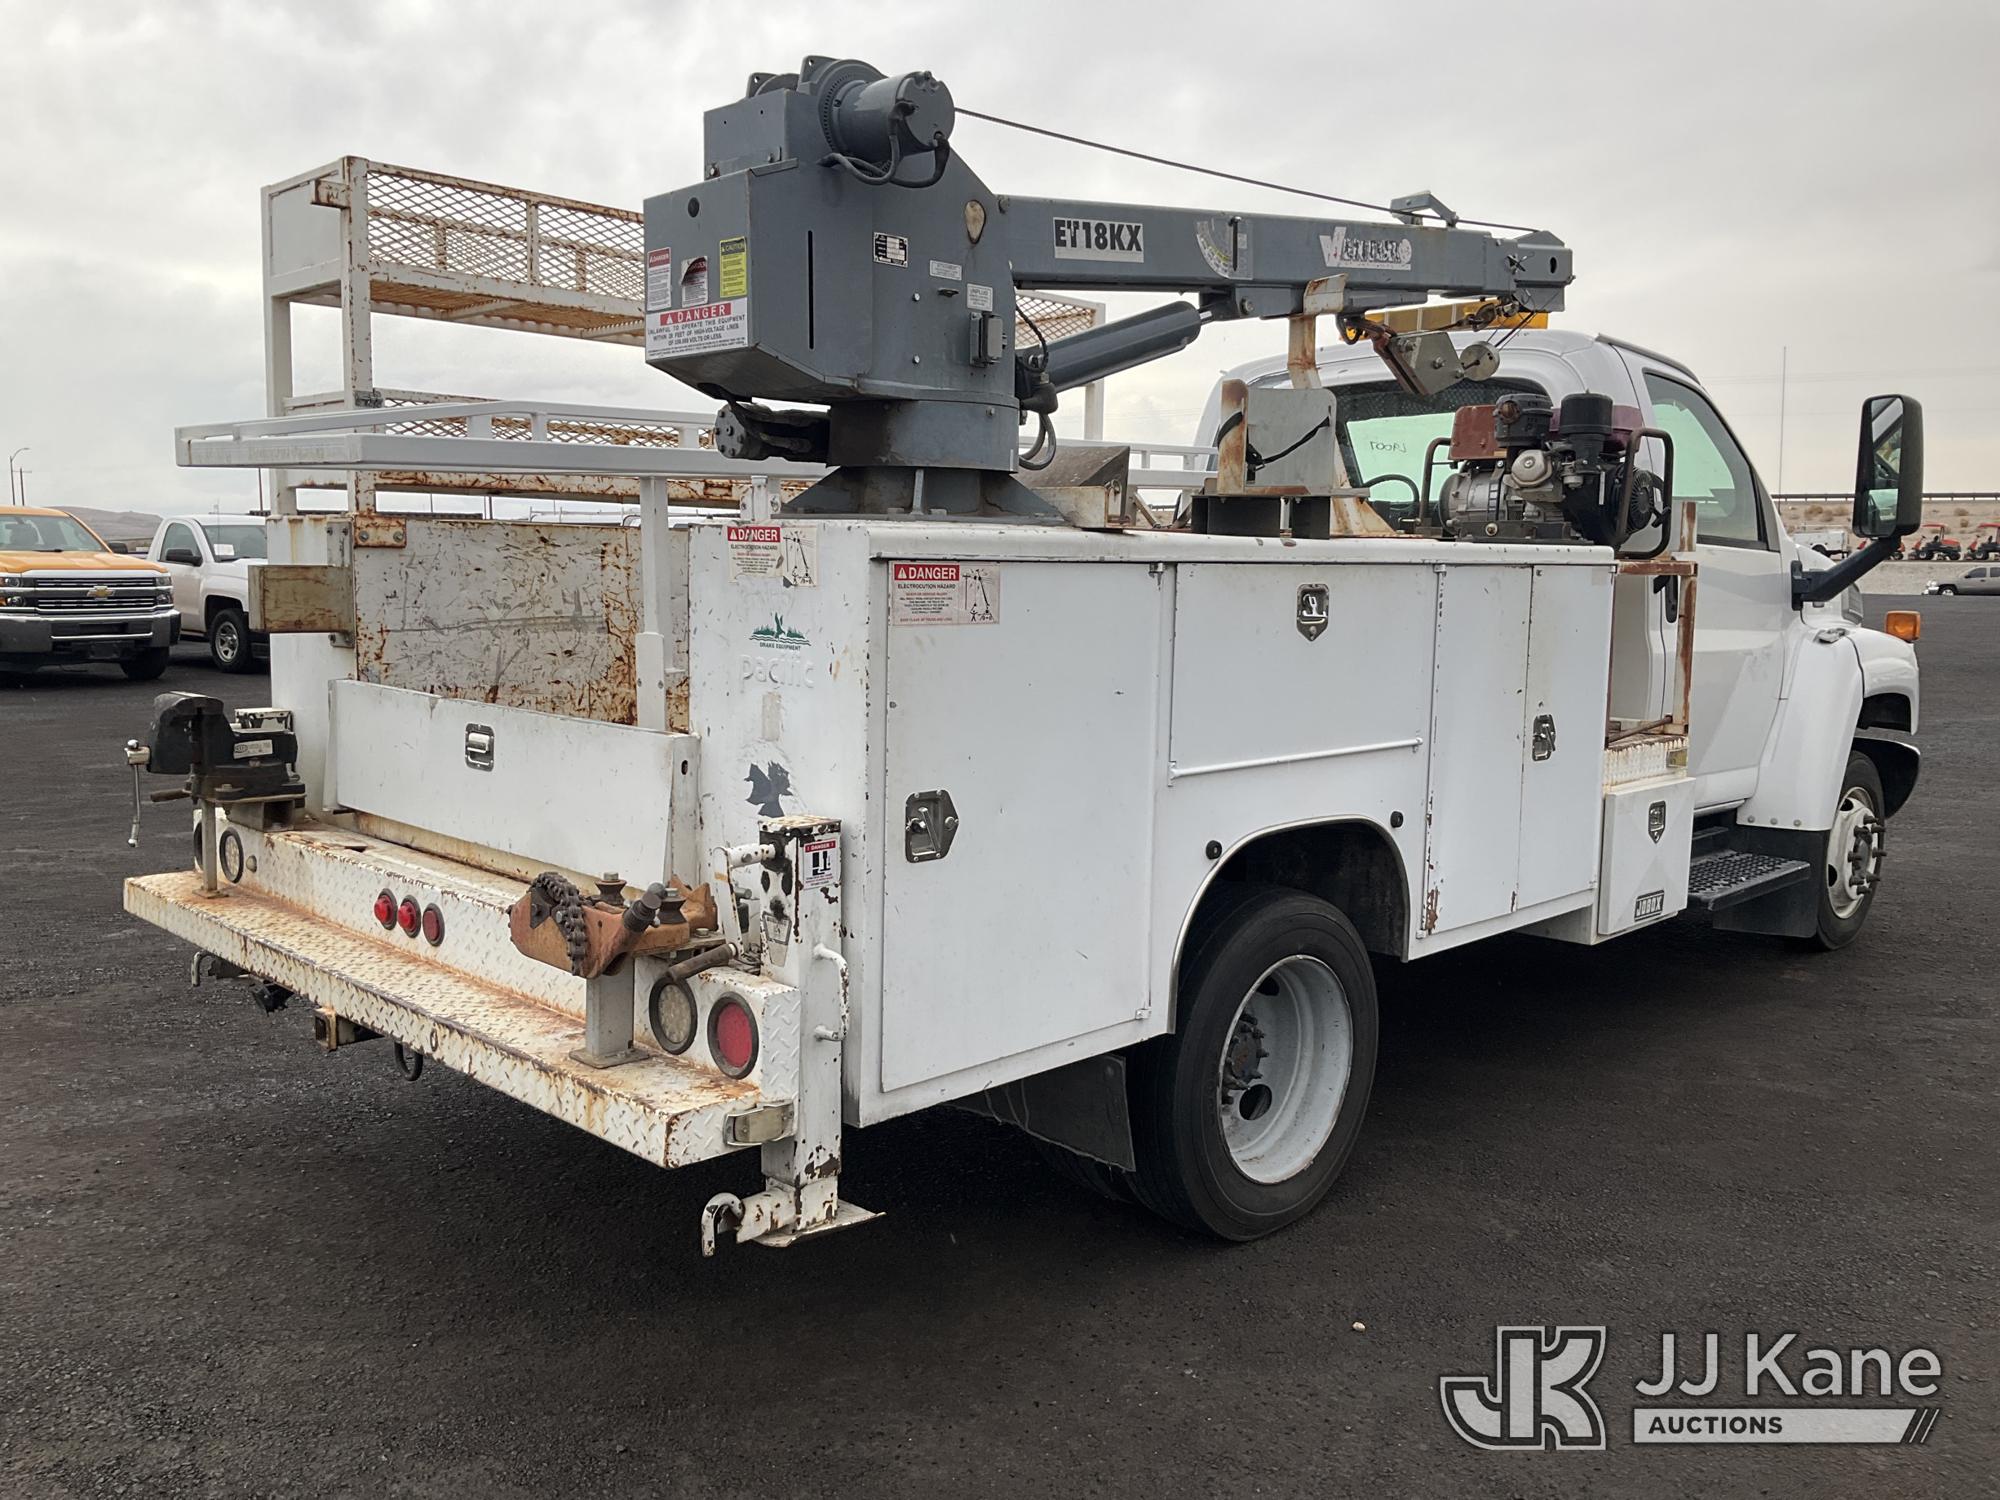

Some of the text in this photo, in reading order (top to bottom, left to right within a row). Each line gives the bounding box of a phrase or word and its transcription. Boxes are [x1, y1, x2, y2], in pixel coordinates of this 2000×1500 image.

[1054, 219, 1142, 251] ET18KX
[677, 305, 726, 322] DANGER
[908, 567, 957, 580] DANGER
